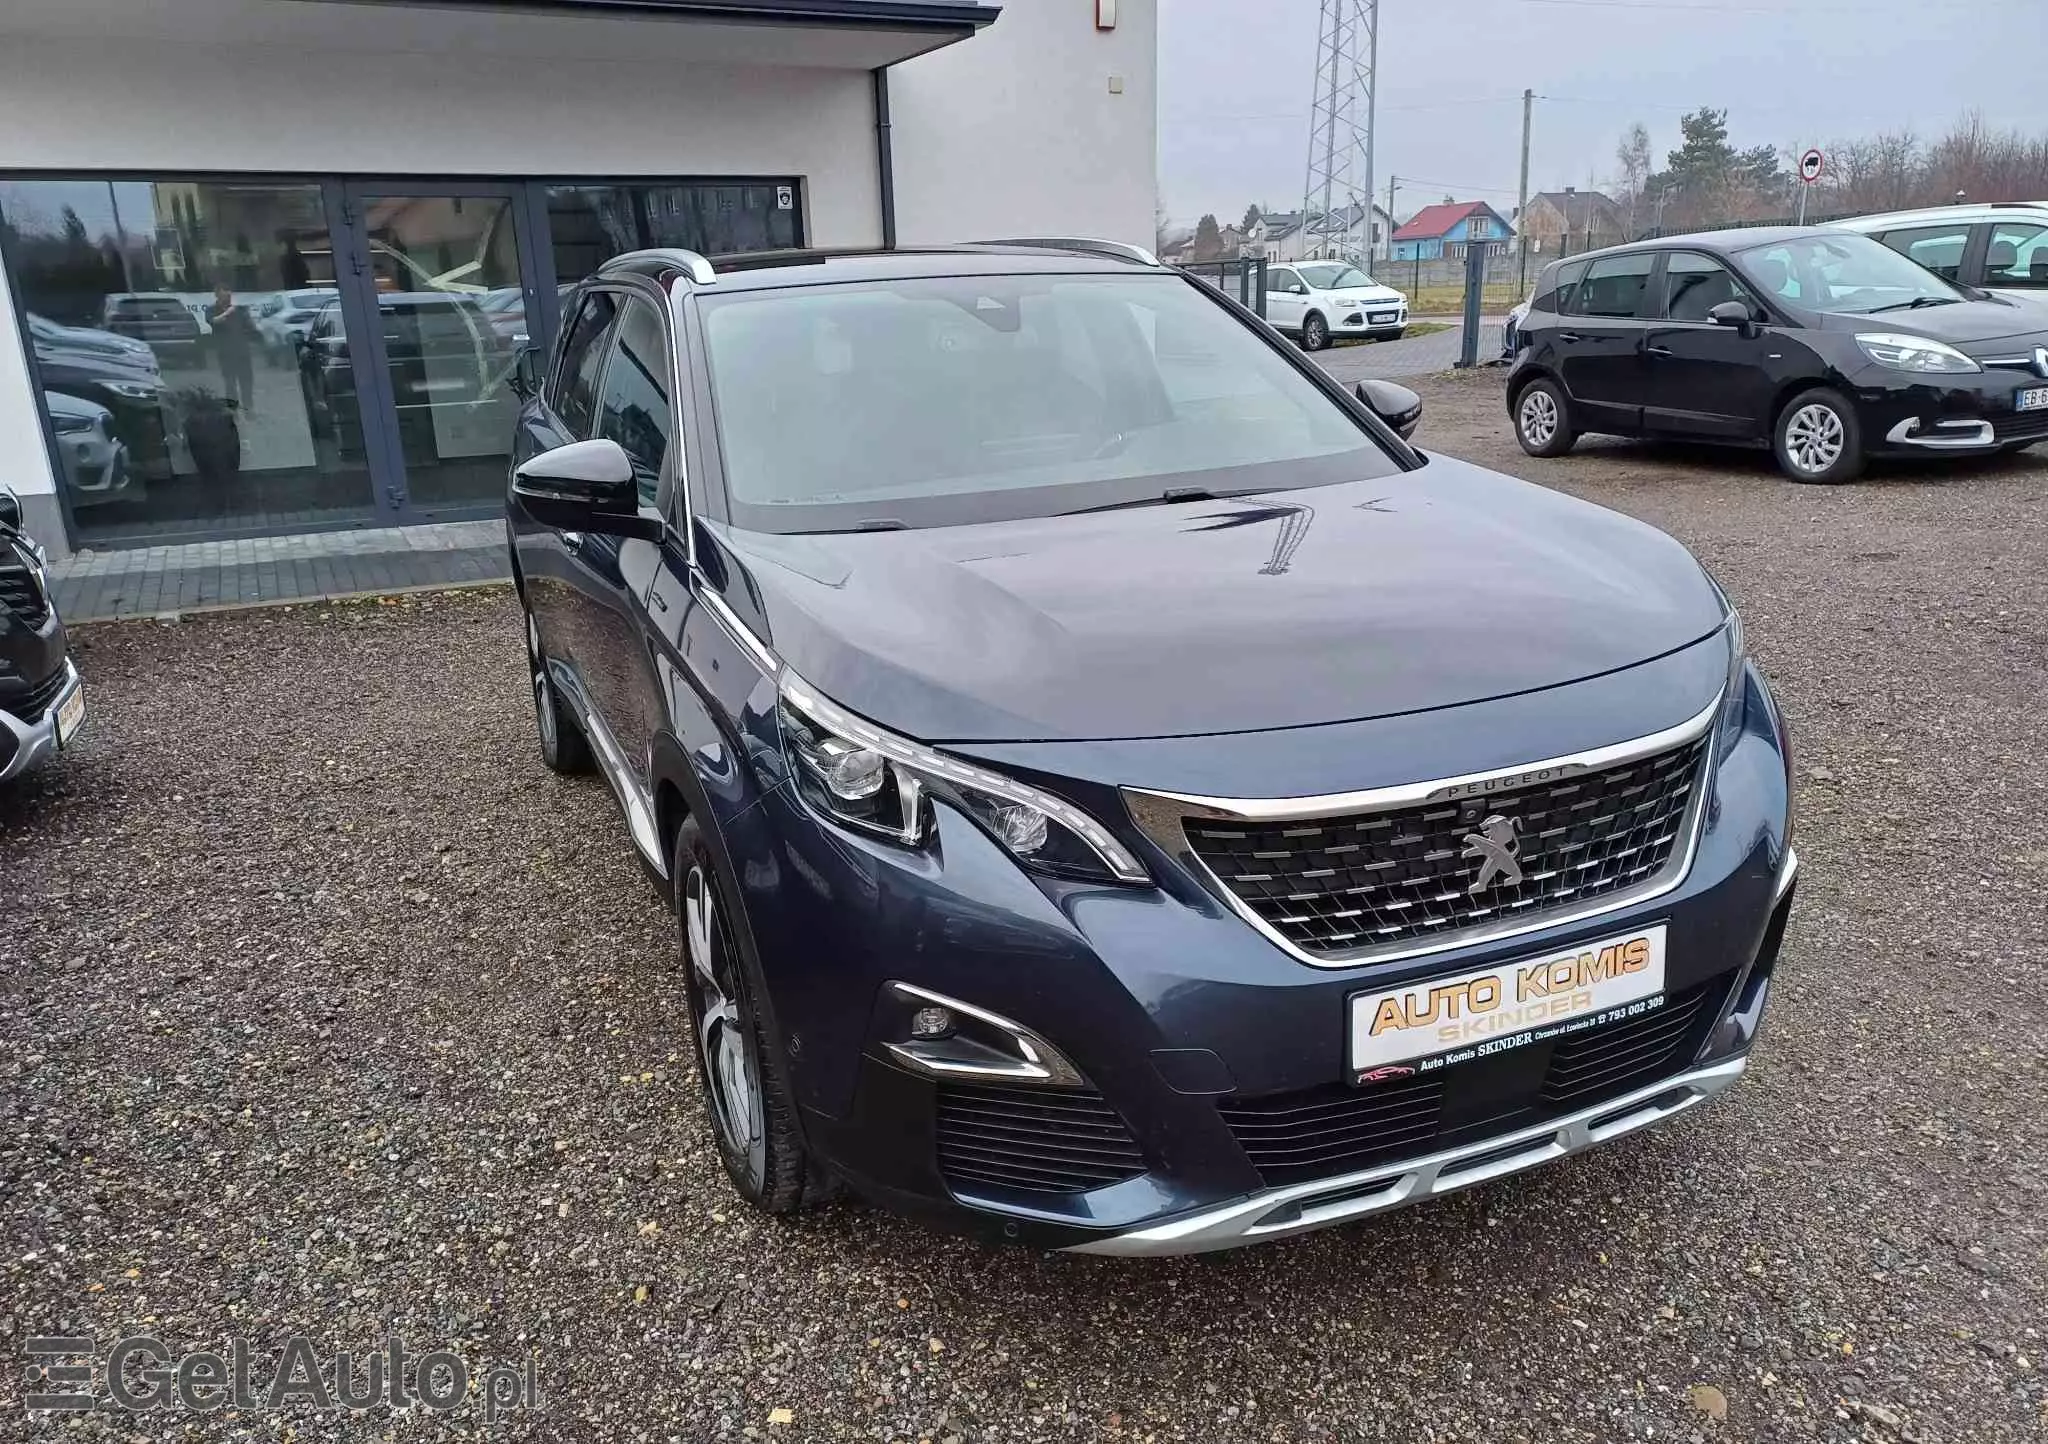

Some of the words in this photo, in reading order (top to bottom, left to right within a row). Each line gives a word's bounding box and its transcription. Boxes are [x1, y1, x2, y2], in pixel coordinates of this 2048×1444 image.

[1448, 766, 1569, 798] PEUGEOT
[1369, 975, 1502, 1036] AUTO
[1517, 937, 1650, 1003] KOMIS
[1437, 991, 1593, 1043] SKINDER
[1420, 1059, 1444, 1072] Auto
[1446, 1050, 1476, 1065] Komis
[1477, 1032, 1533, 1057] SKINDER
[1608, 1008, 1626, 1022] 793
[1628, 1001, 1646, 1016] 002
[1647, 995, 1665, 1010] 309
